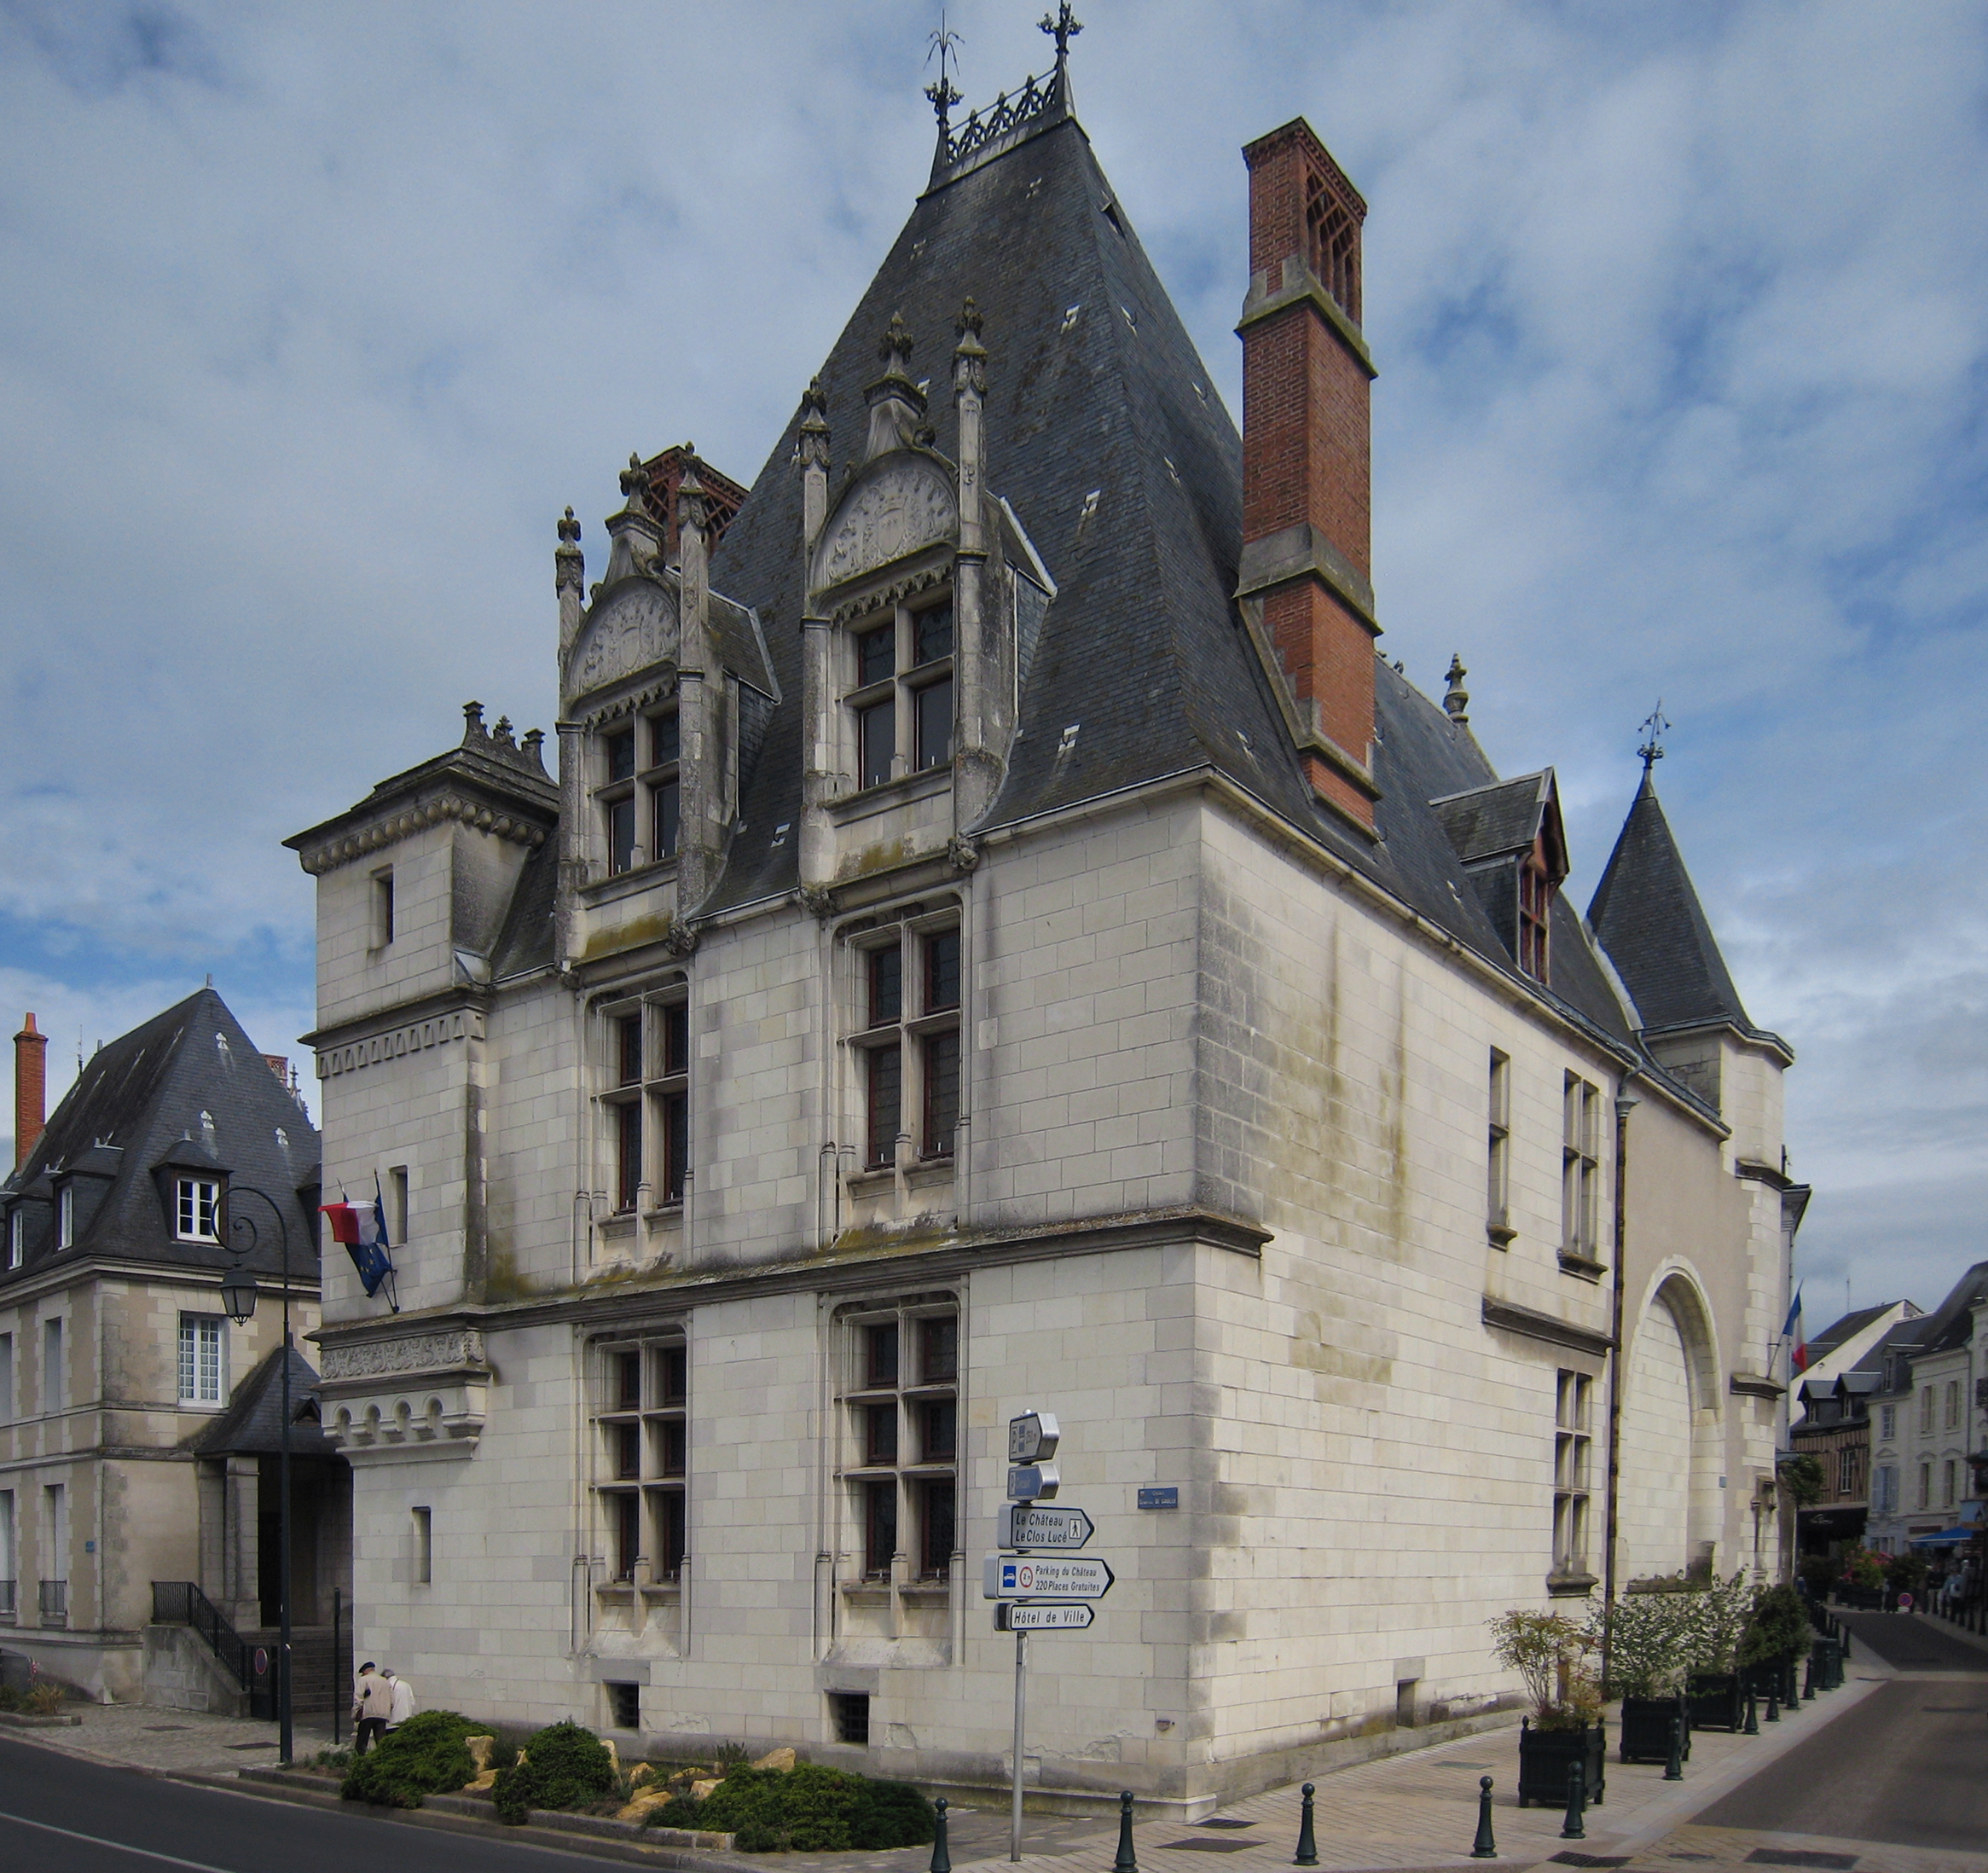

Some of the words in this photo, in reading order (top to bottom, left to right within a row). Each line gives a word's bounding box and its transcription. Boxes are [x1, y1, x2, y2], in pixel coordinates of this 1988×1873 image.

[1016, 1513, 1025, 1524] Le
[1029, 1514, 1063, 1526] Château
[1016, 1530, 1025, 1541] Le
[1027, 1530, 1044, 1542] Clos
[1048, 1531, 1067, 1542] Lucé
[1035, 1566, 1059, 1578] Parking
[1062, 1567, 1069, 1575] du
[1072, 1567, 1097, 1577] Château
[1035, 1581, 1047, 1590] 220
[1048, 1581, 1069, 1591] Places
[1071, 1582, 1099, 1592] Gratuites
[1014, 1611, 1040, 1623] Hôtel
[1046, 1612, 1056, 1622] de
[1064, 1611, 1084, 1622] Ville
